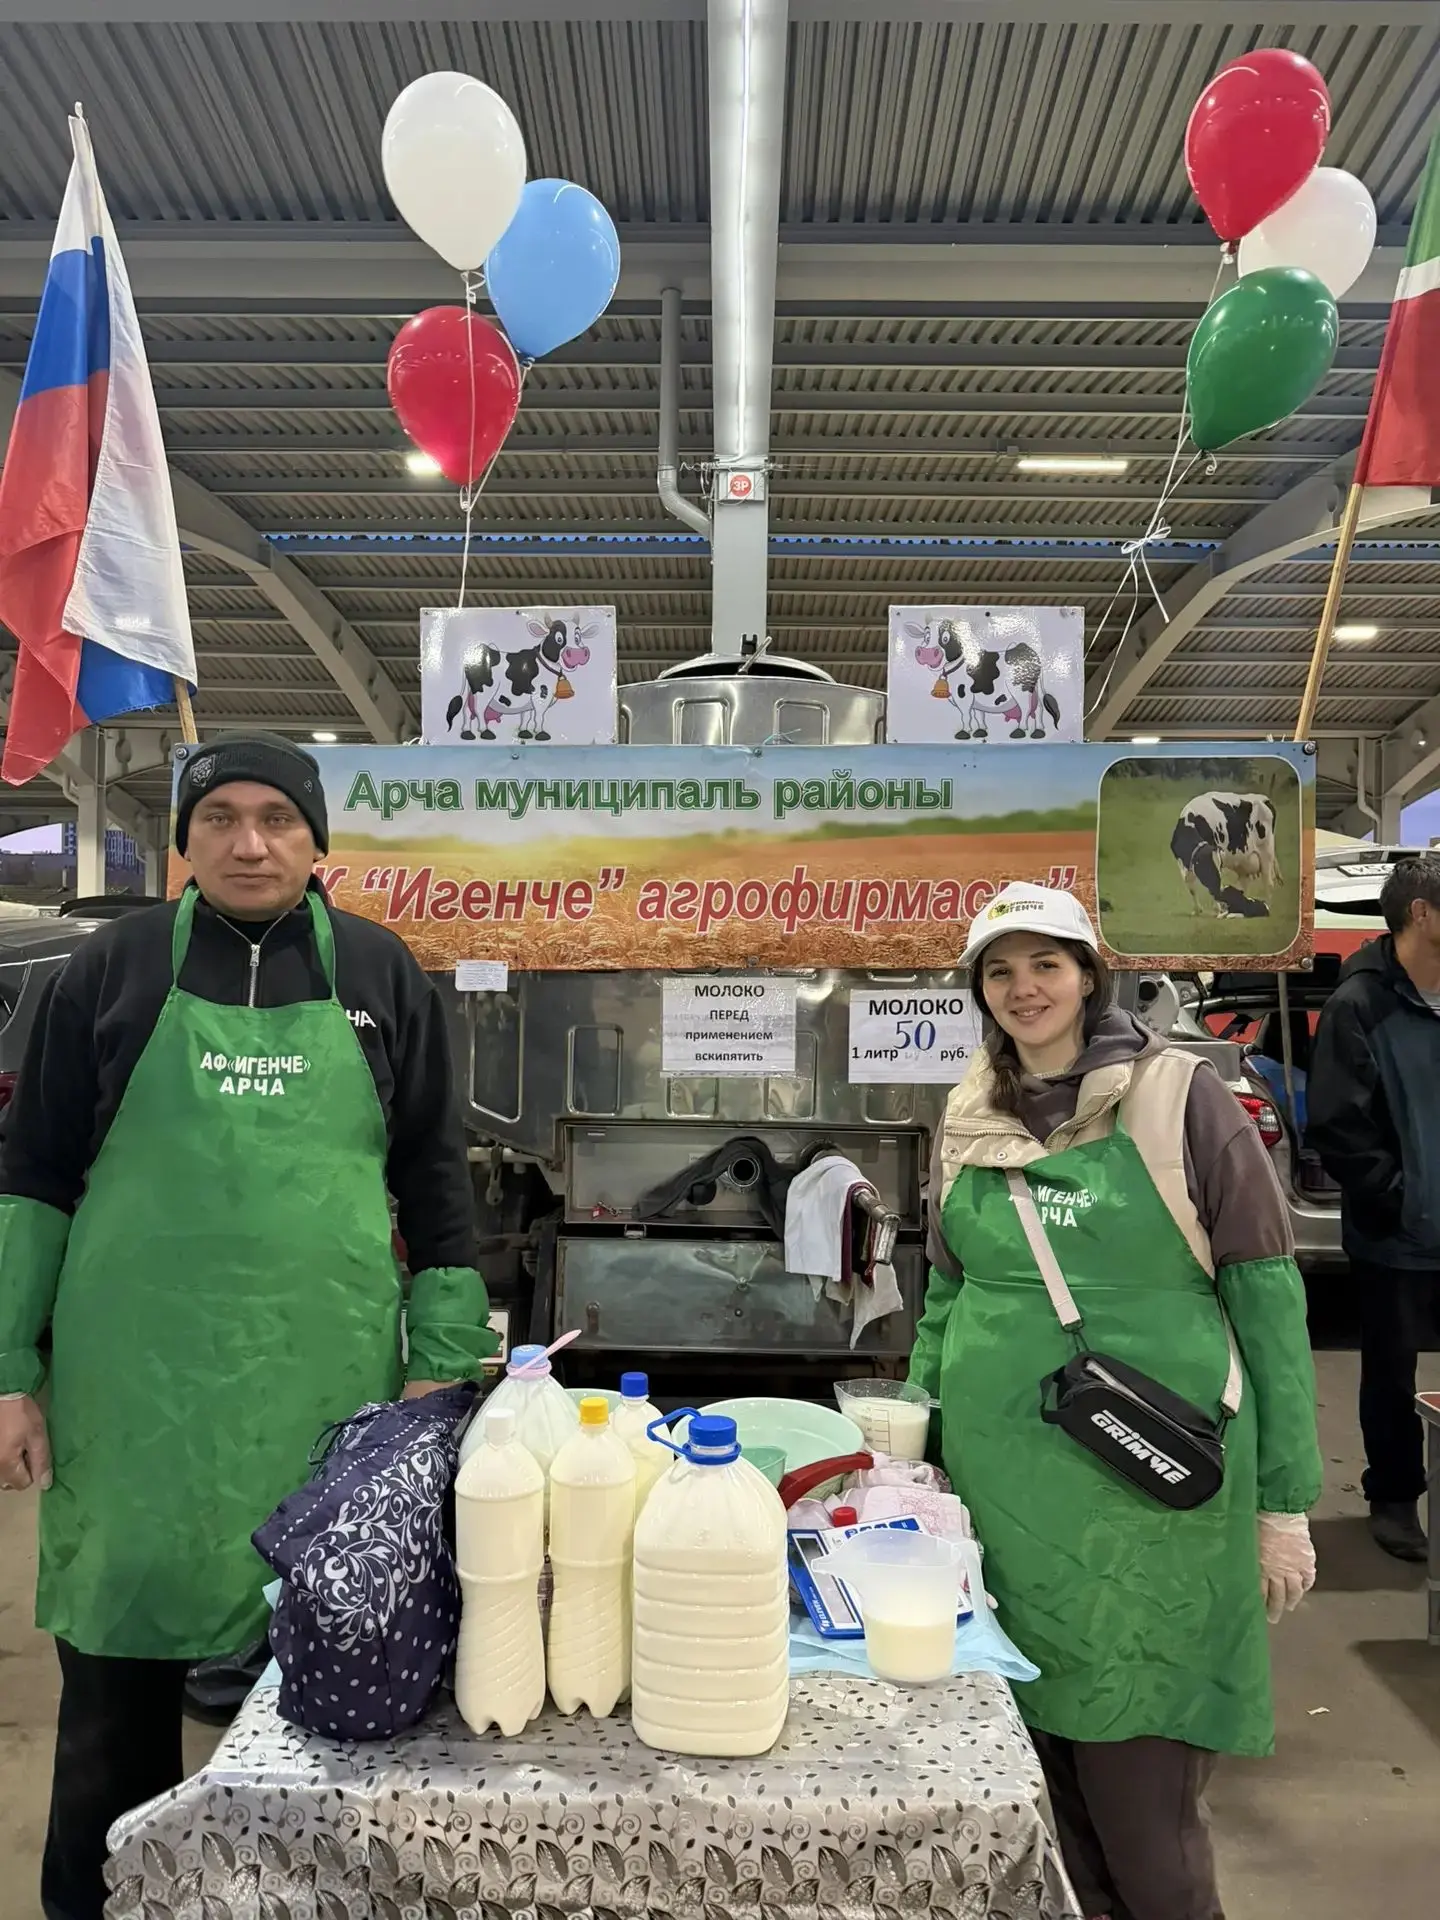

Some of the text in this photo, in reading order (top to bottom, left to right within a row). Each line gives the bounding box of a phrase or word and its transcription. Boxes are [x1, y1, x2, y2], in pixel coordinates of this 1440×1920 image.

[344, 769, 952, 820] Арча муниципаль районы
[362, 865, 626, 922] “Игенче”
[637, 865, 1077, 934] агрофирмас”
[694, 985, 765, 997] МОЛОКО
[868, 998, 964, 1015] МОЛОКО
[346, 1009, 377, 1028] ЧА
[709, 1009, 750, 1022] ПЕРЕД
[685, 1031, 773, 1042] применением
[893, 1020, 936, 1051] 50
[695, 1052, 763, 1062] вскипятить
[852, 1047, 860, 1058] 1
[864, 1049, 899, 1061] литр
[940, 1047, 968, 1061] руб.
[219, 1077, 285, 1095] АРЧА
[1041, 1206, 1077, 1227] РЧА
